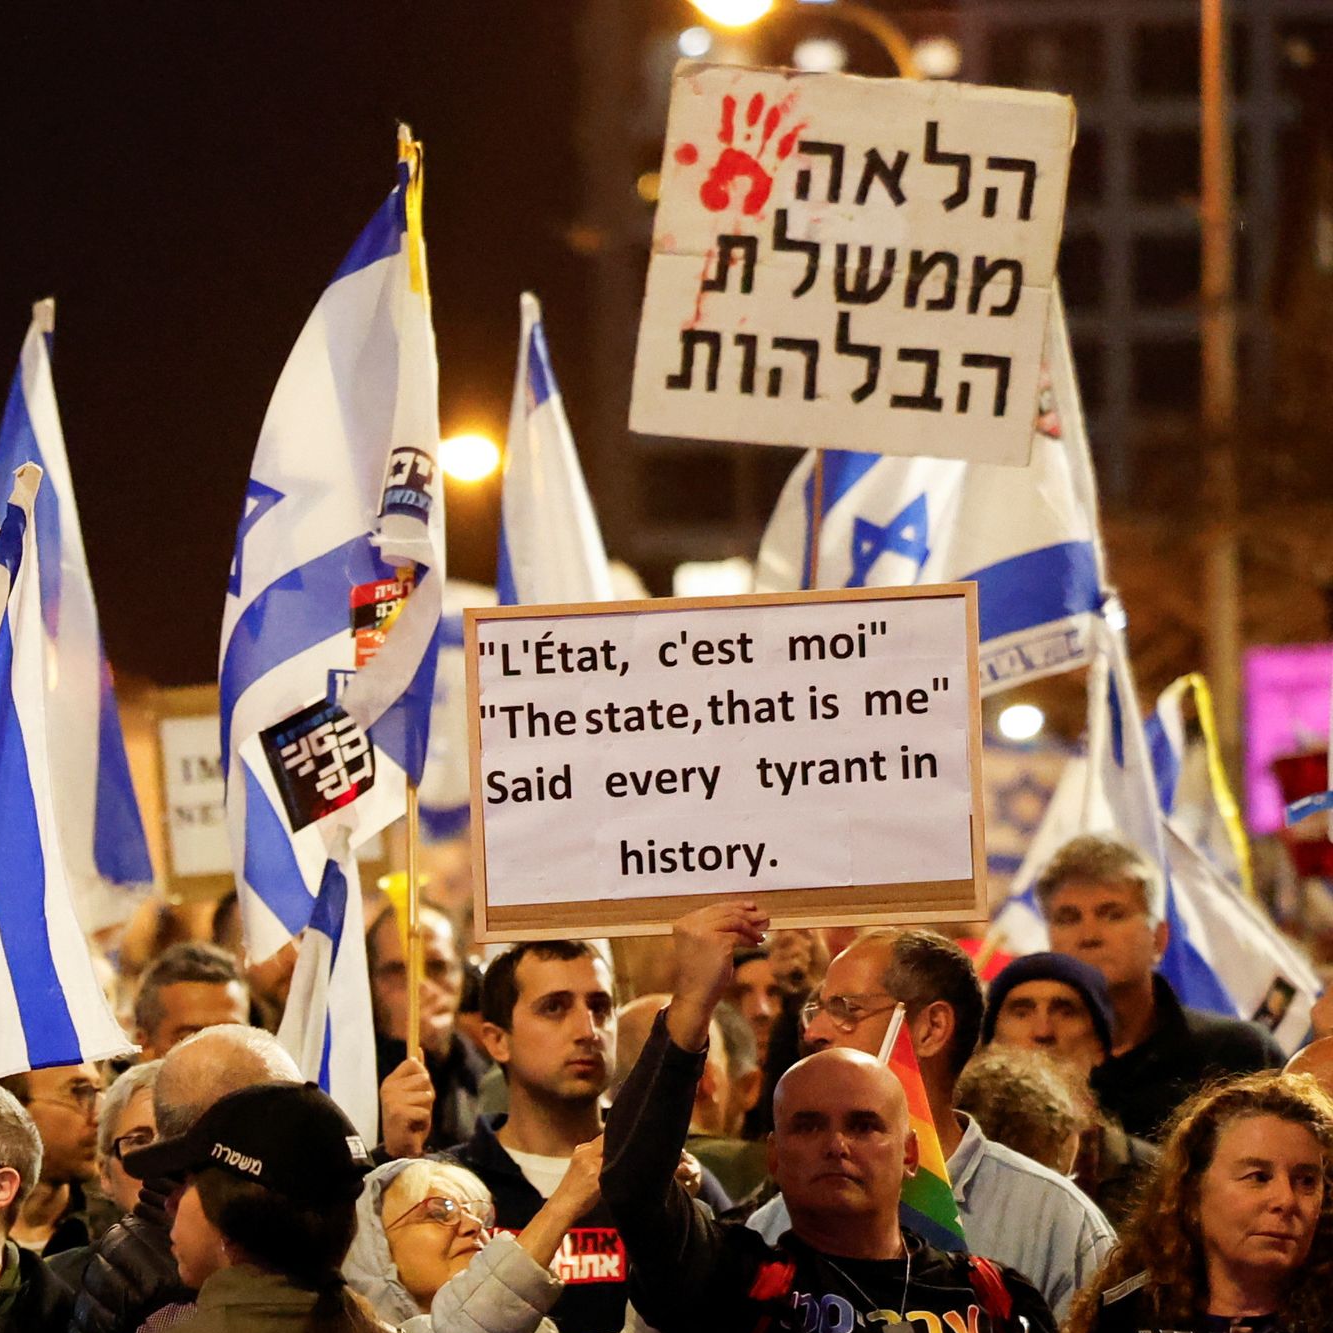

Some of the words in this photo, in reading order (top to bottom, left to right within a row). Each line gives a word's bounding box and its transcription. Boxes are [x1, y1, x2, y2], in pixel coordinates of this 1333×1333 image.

[795, 121, 1037, 221] הלאה
[701, 208, 1025, 317] ממשלת
[665, 311, 1012, 417] הבלהות
[479, 631, 631, 679] "L'État,
[657, 630, 755, 667] c'est
[787, 620, 888, 662] moi"
[479, 702, 577, 739] "The
[809, 685, 840, 721] is
[863, 677, 950, 717] me"
[486, 764, 573, 806] Said
[604, 762, 721, 800] every
[756, 748, 887, 796] tyrant
[900, 745, 939, 781] in
[619, 839, 779, 877] history.
[211, 1142, 263, 1177] משטרה
